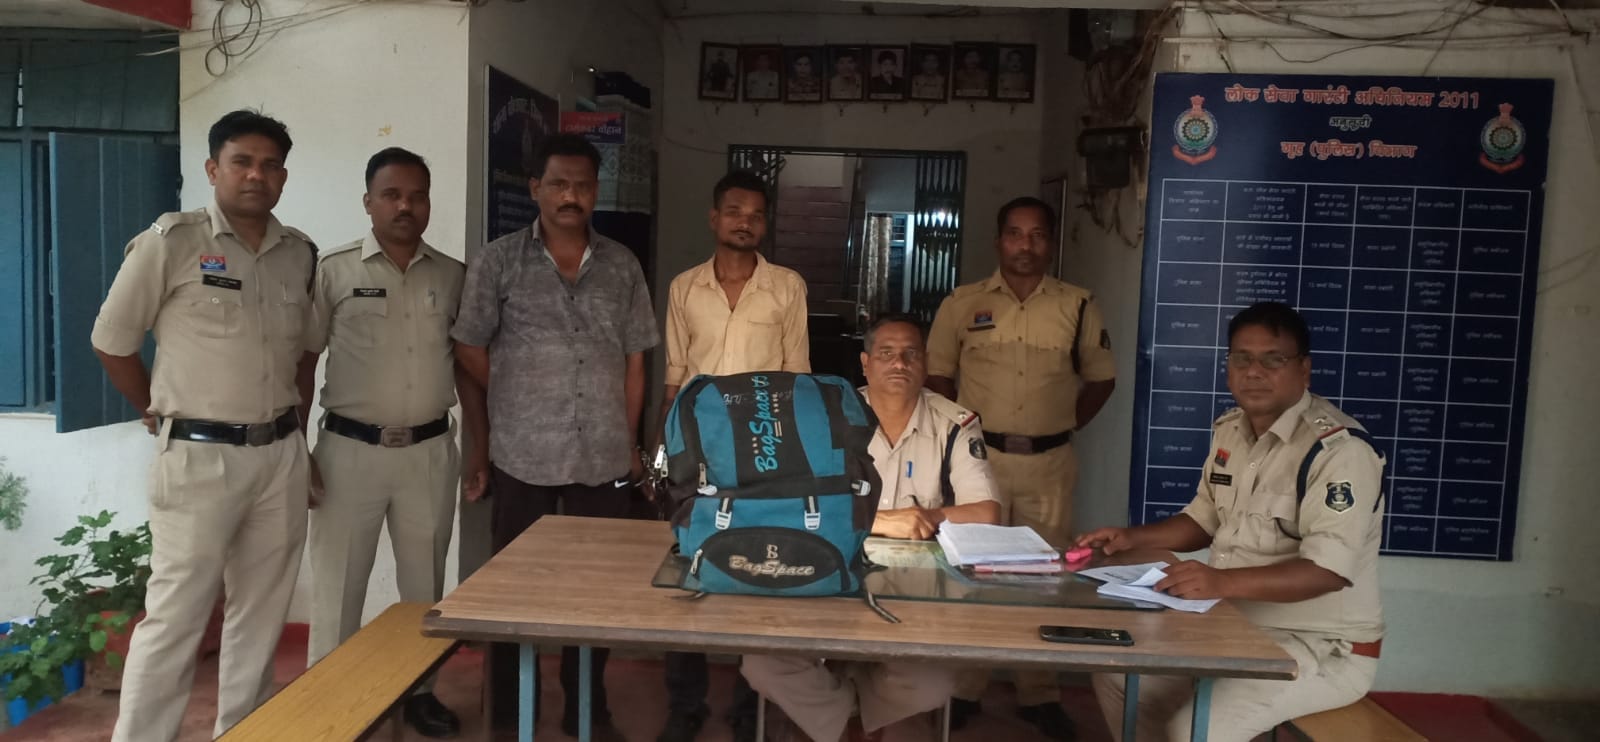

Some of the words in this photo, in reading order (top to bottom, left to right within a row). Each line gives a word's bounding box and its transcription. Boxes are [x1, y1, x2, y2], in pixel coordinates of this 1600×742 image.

[1224, 84, 1260, 104] लोक
[1263, 85, 1299, 104] सेवा
[1303, 84, 1350, 106] गारंटी
[1354, 86, 1435, 108] अधिनियम
[1438, 90, 1479, 109] 2011
[1309, 138, 1364, 160] (पुलिस)
[1368, 140, 1418, 158] विभाग
[748, 389, 783, 473] BagSpace
[728, 554, 815, 578] BagSpace
